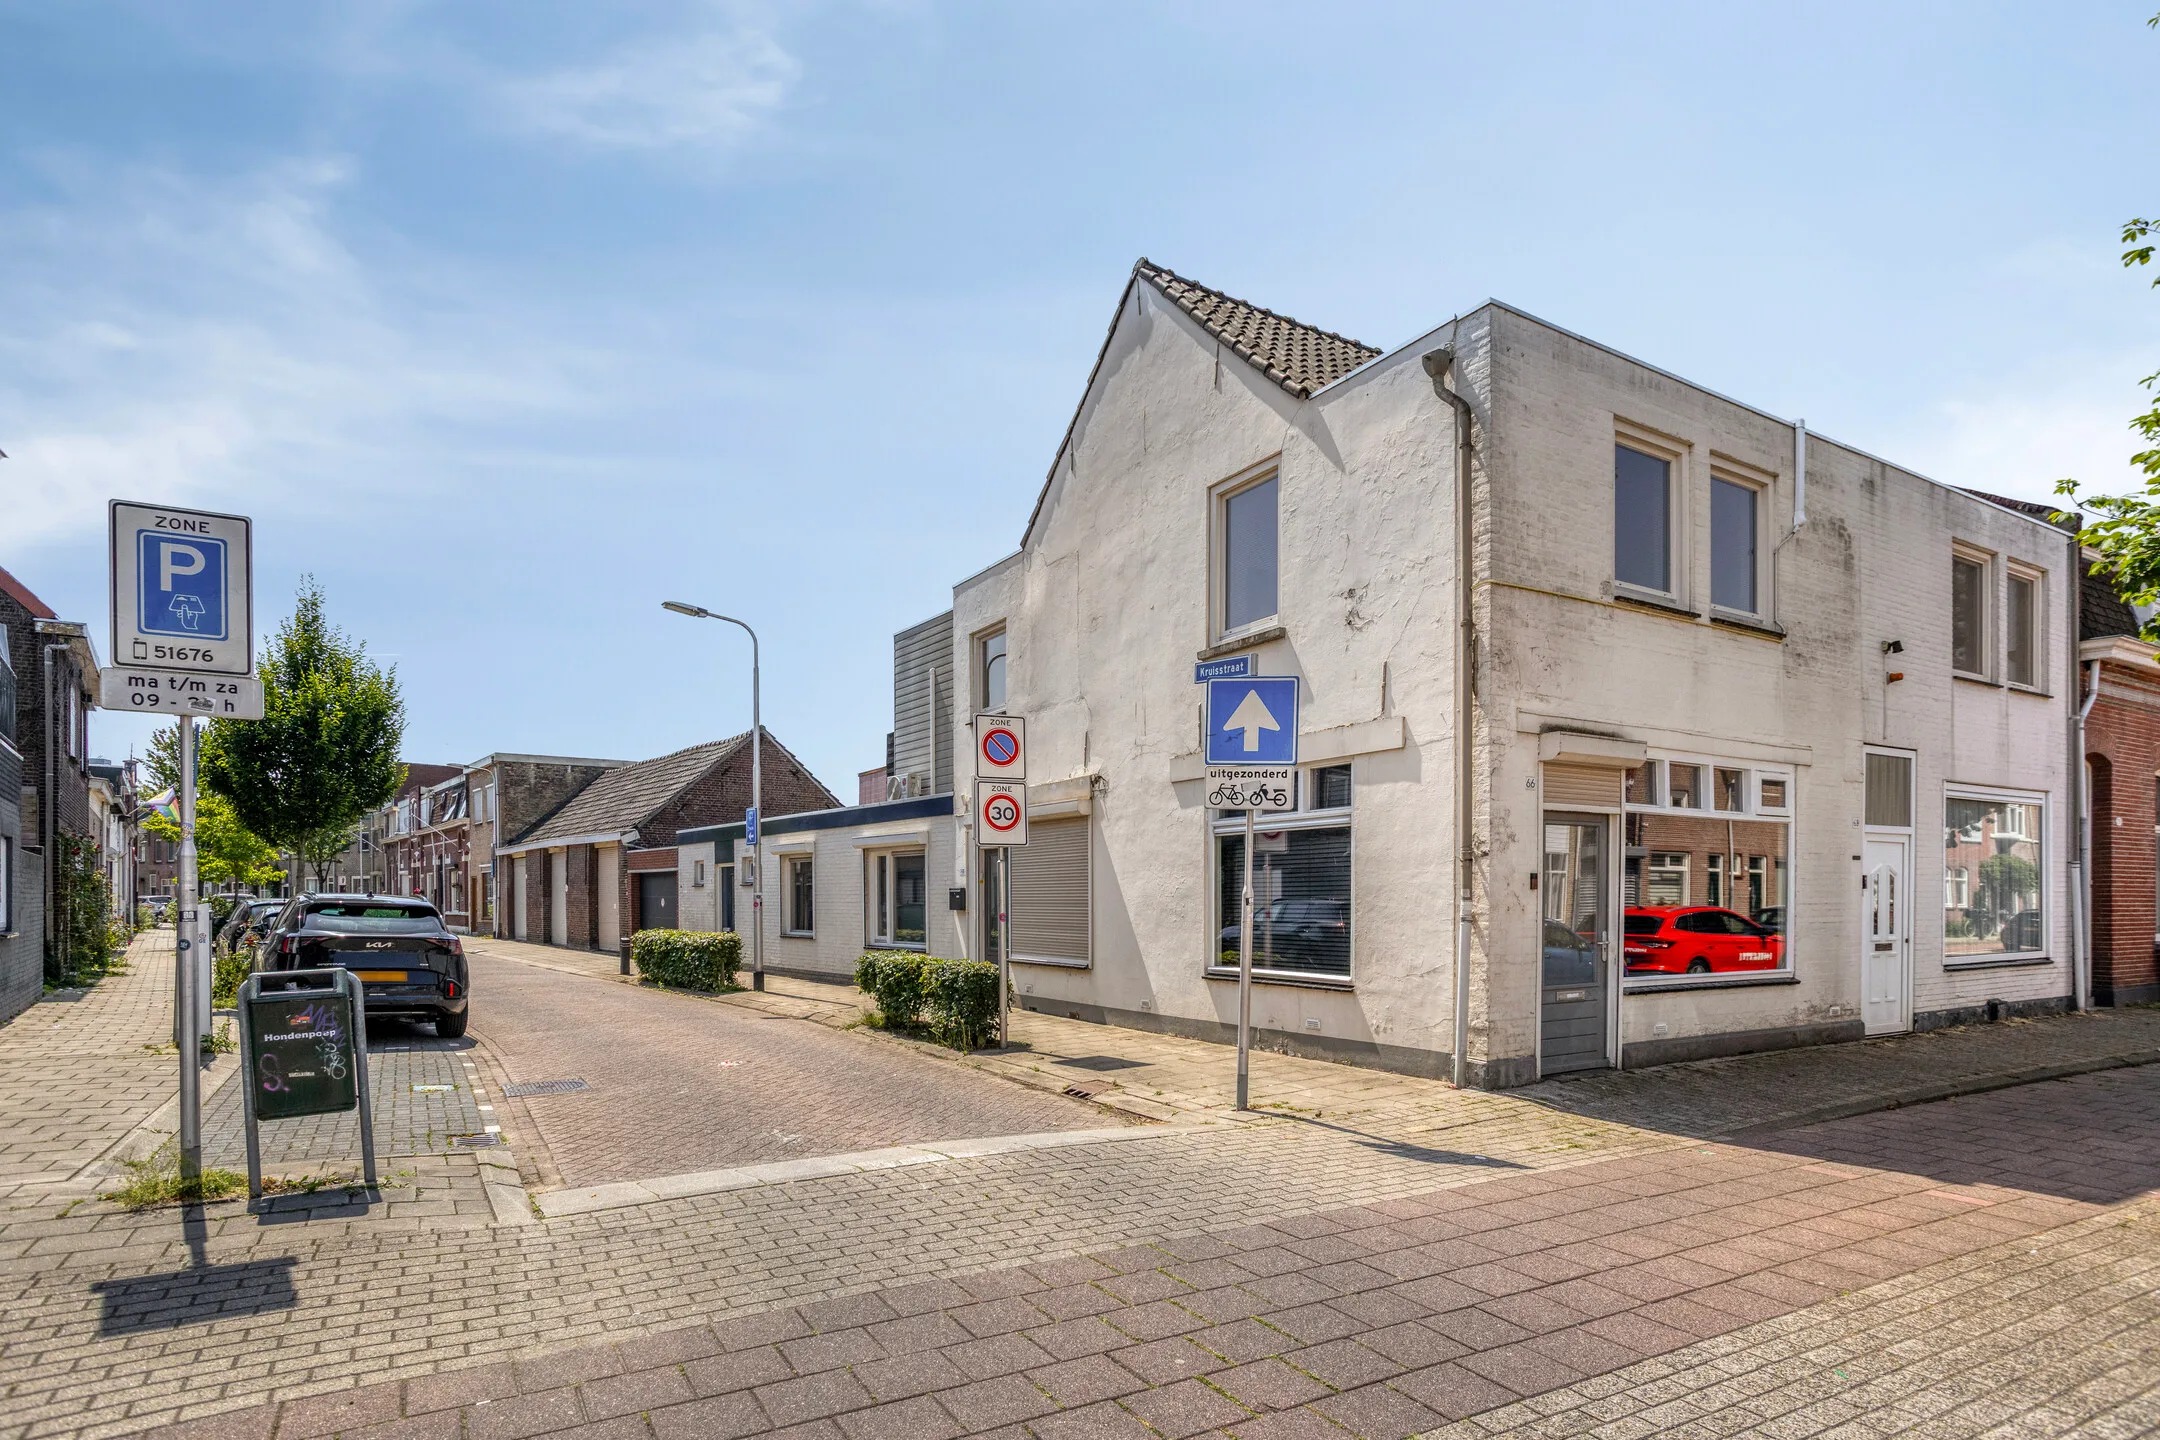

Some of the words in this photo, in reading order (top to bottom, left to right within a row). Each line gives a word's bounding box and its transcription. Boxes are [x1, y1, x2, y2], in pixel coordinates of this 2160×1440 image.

[154, 515, 210, 534] ZONE
[159, 541, 206, 592] P
[154, 645, 214, 662] 51676
[1199, 662, 1244, 678] Kruisstraat
[128, 674, 158, 689] ma
[168, 676, 206, 692] t/m
[216, 682, 238, 695] za
[131, 692, 160, 707] 09
[224, 699, 235, 713] h
[990, 719, 1012, 727] ZONE
[1210, 769, 1288, 781] uitgezonderd
[991, 785, 1013, 793] ZONE
[1526, 778, 1536, 788] 66
[991, 806, 1015, 821] 30
[263, 1029, 336, 1042] Hondenpoep
